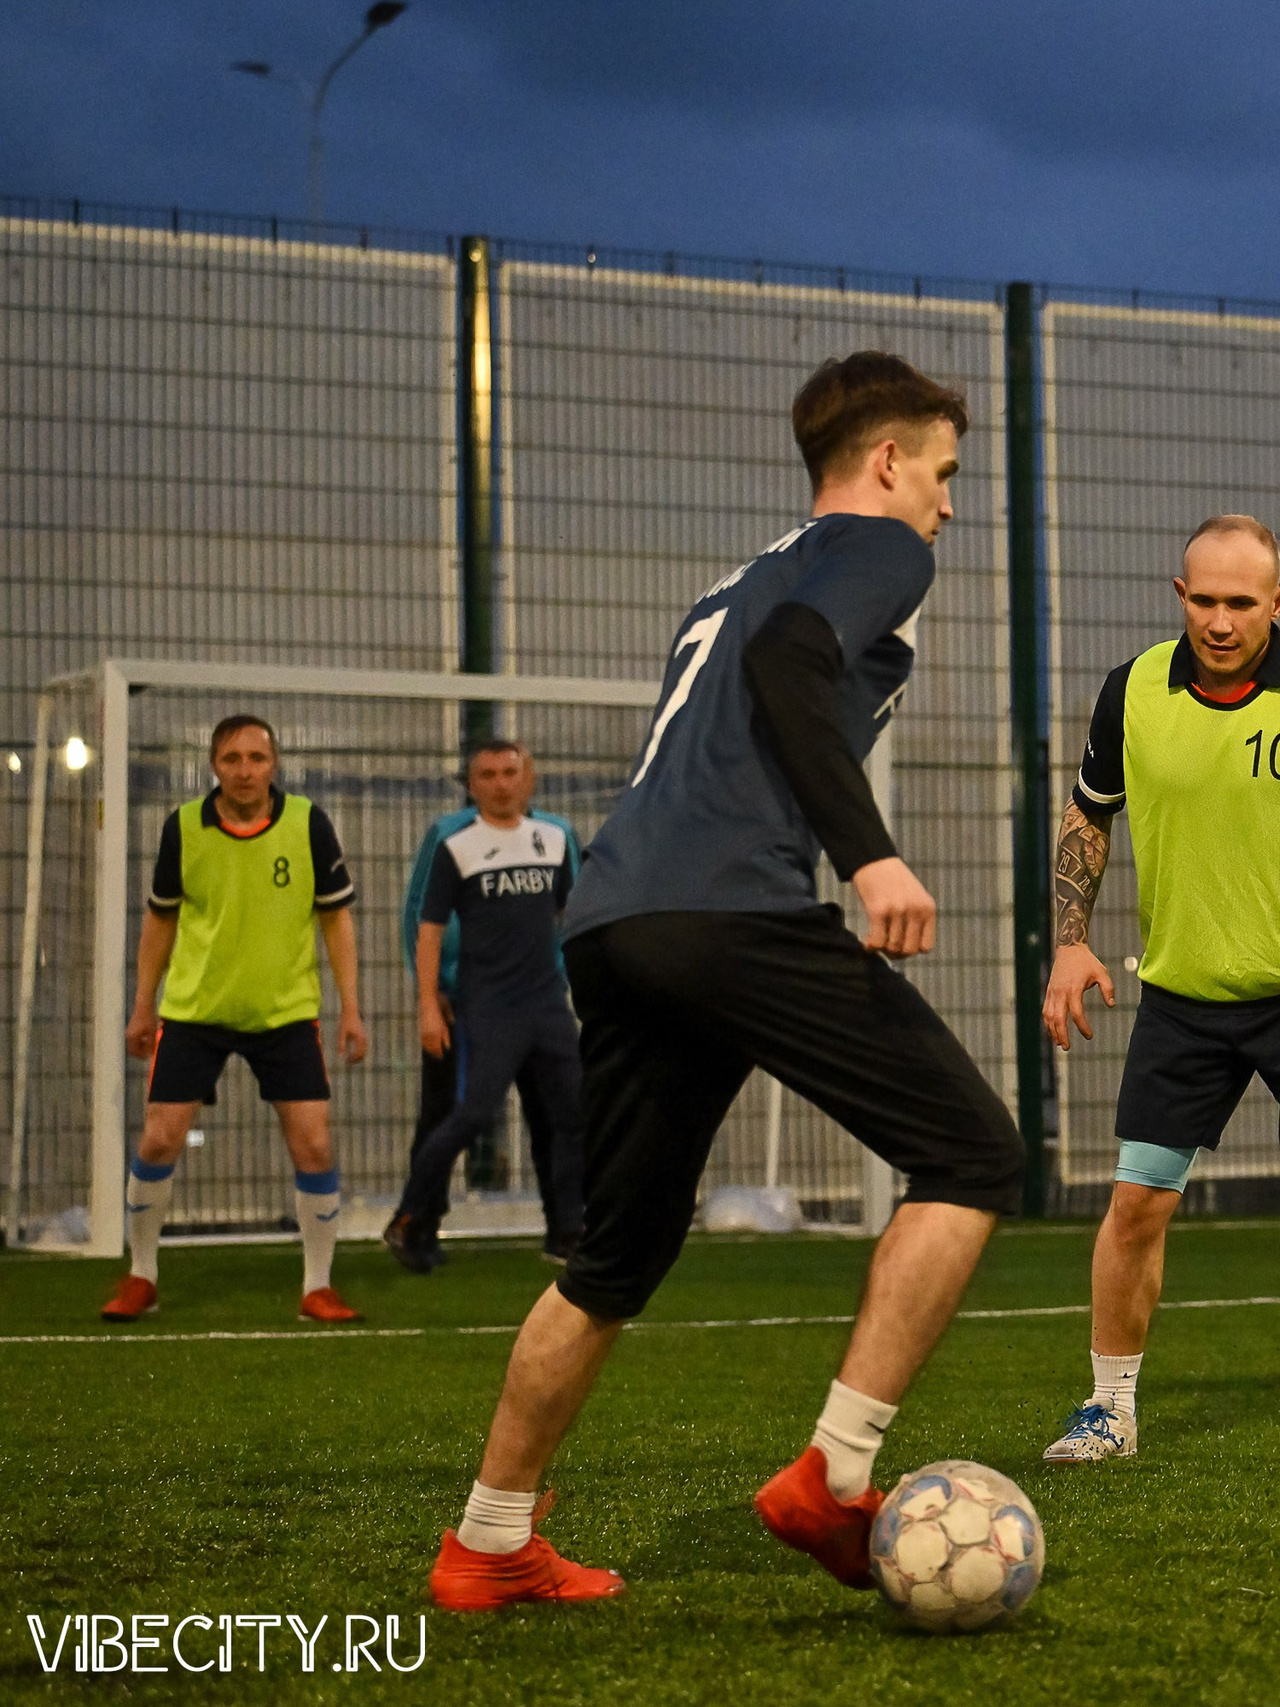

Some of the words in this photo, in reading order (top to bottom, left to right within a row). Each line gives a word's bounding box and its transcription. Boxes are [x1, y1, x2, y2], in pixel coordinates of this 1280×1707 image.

[632, 607, 729, 788] 7
[272, 856, 291, 888] 8
[1058, 851, 1071, 874] 29
[481, 867, 555, 899] FARBY
